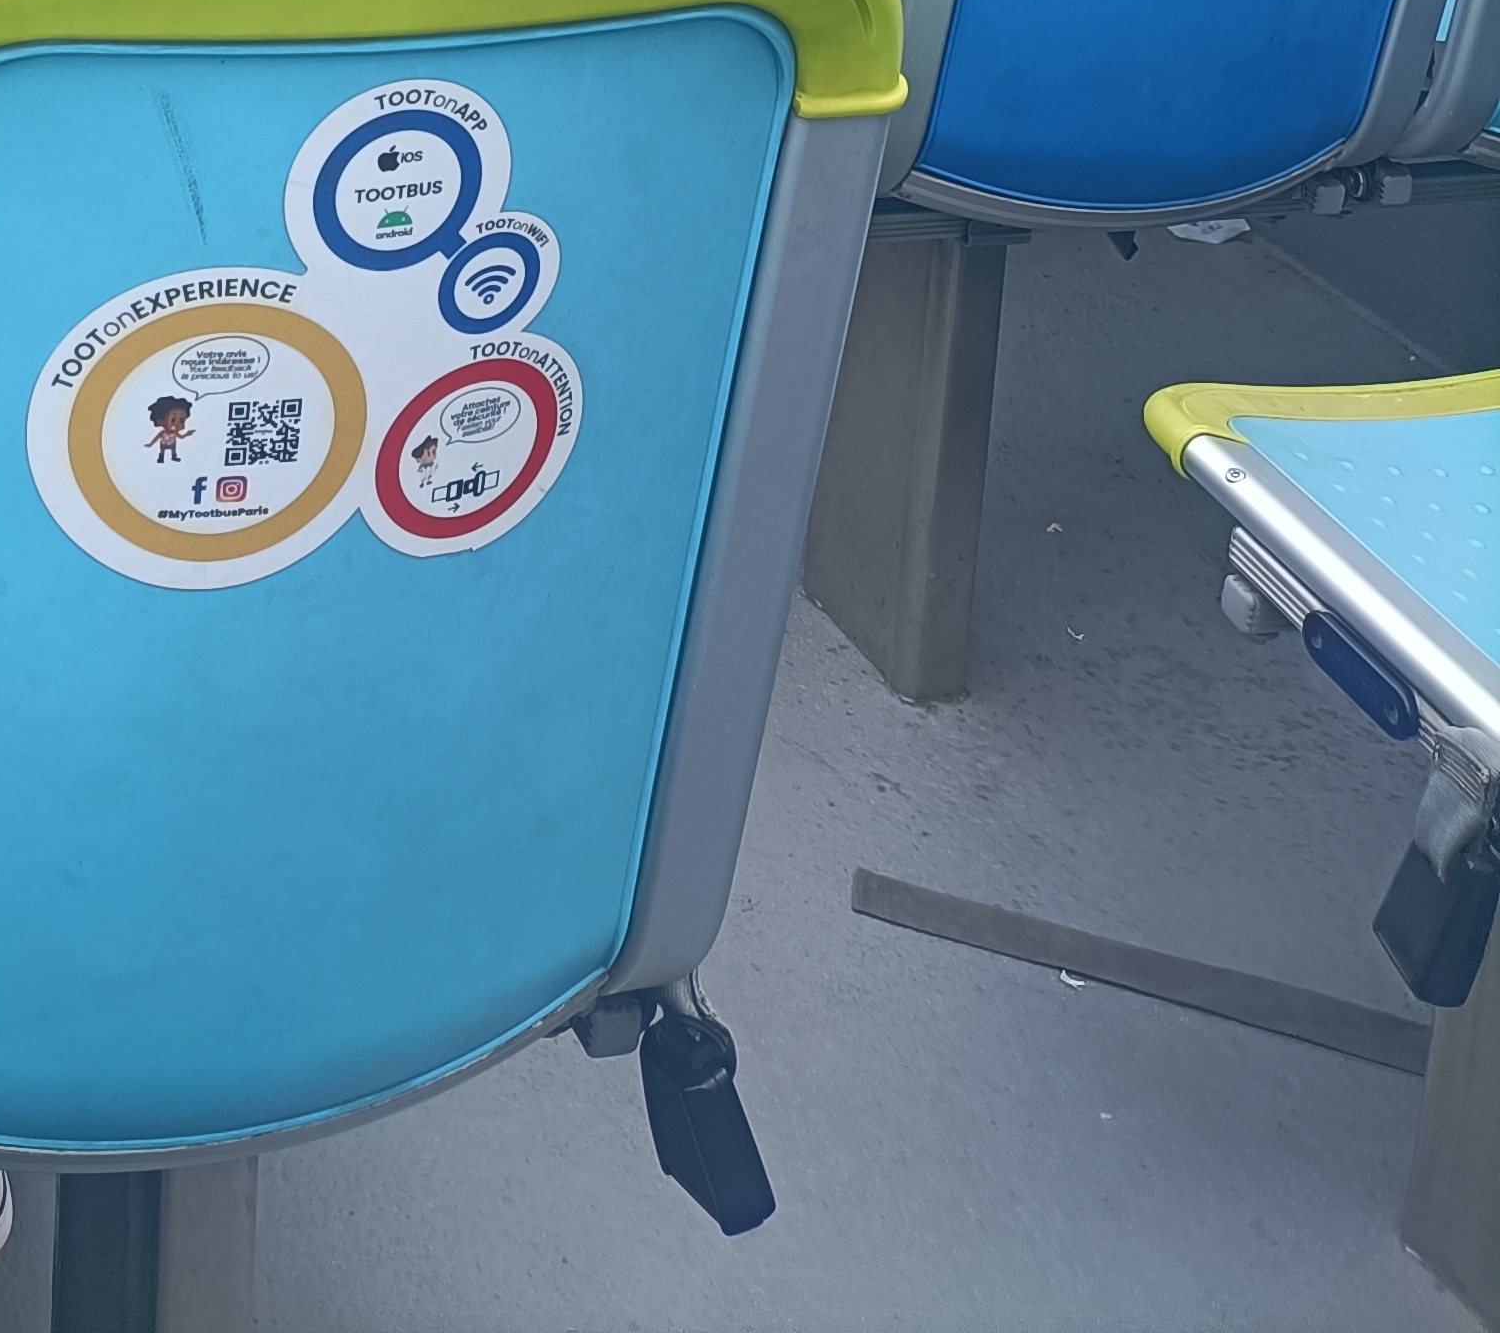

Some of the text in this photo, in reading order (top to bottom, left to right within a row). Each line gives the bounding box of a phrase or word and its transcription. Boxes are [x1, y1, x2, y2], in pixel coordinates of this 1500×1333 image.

[373, 89, 488, 132] TOOTonAPP
[401, 150, 424, 169] iOS
[354, 180, 443, 204] TOOTBUS
[374, 227, 414, 240] android
[475, 218, 550, 249] TOOTonWIFI
[50, 278, 298, 389] TOOTonEXPERIENCE
[469, 340, 573, 437] TOOTonATTENTION
[156, 506, 270, 520] #MyTootbusParis
